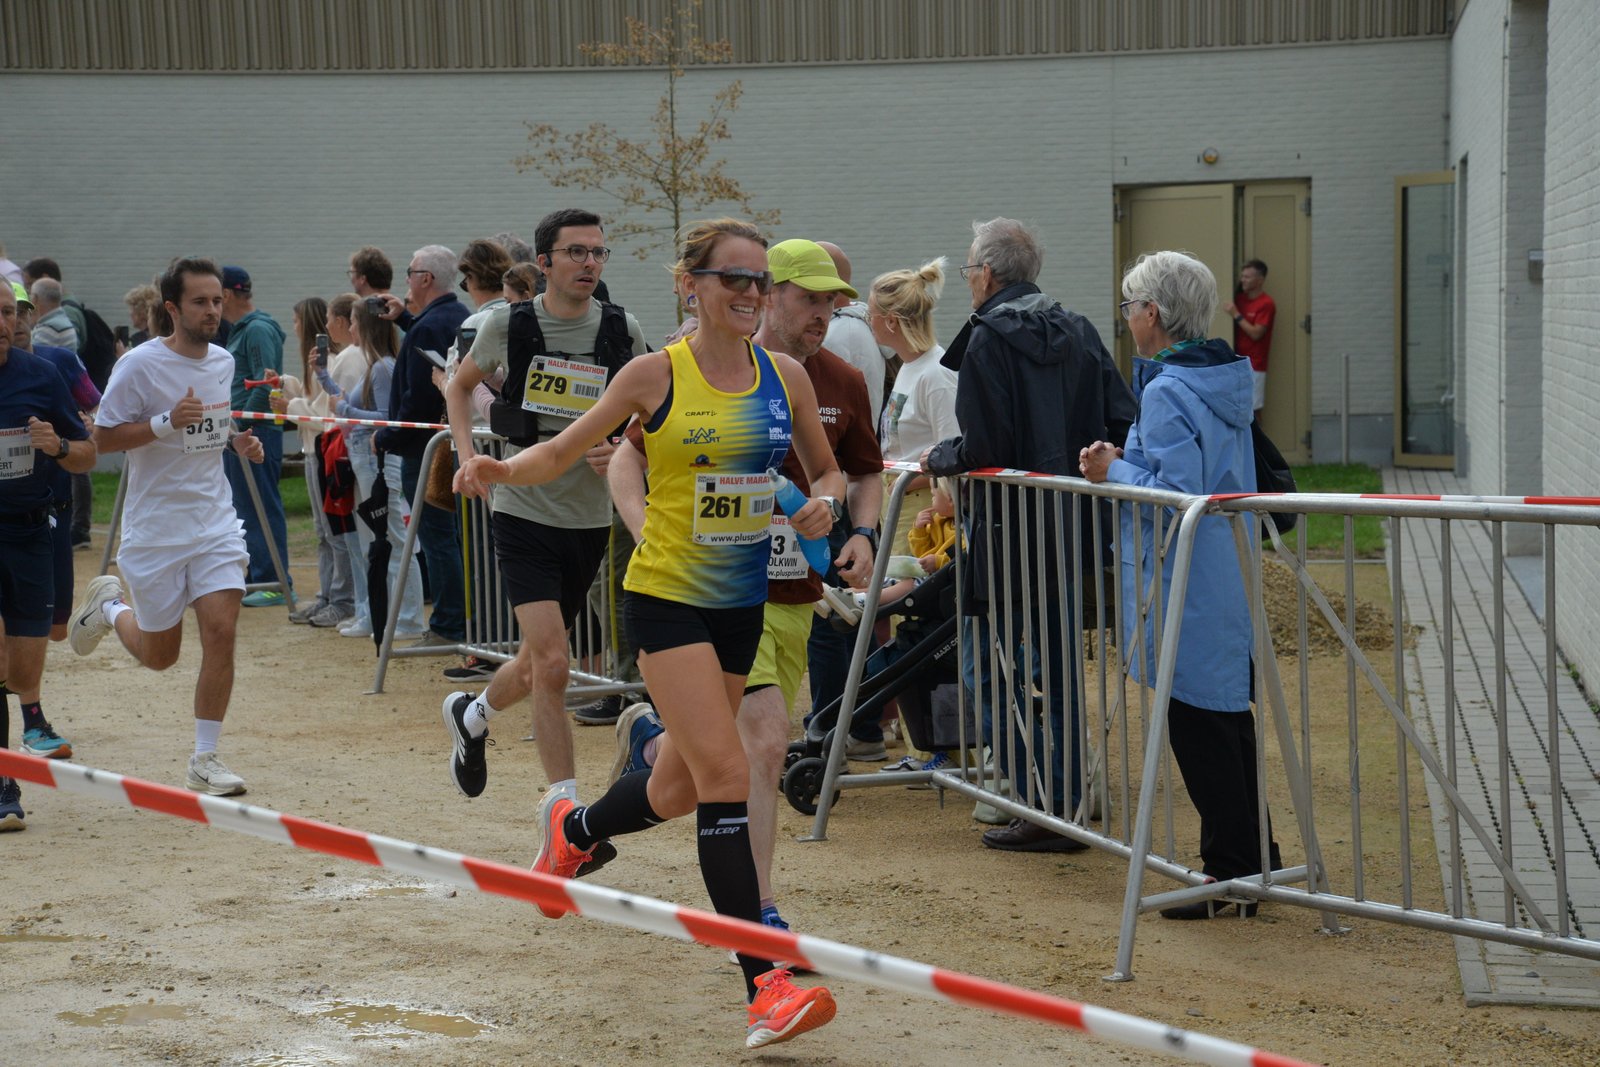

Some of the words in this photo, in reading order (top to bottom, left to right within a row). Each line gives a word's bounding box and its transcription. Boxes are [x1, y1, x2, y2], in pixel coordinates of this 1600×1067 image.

[547, 359, 568, 369] HALVE
[570, 363, 605, 375] MARATHON
[529, 372, 567, 395] 279
[186, 417, 214, 435] 573
[719, 476, 745, 485] HALVE
[700, 495, 742, 518] 261
[710, 529, 769, 543] www.plusprint.be
[770, 535, 786, 555] 3
